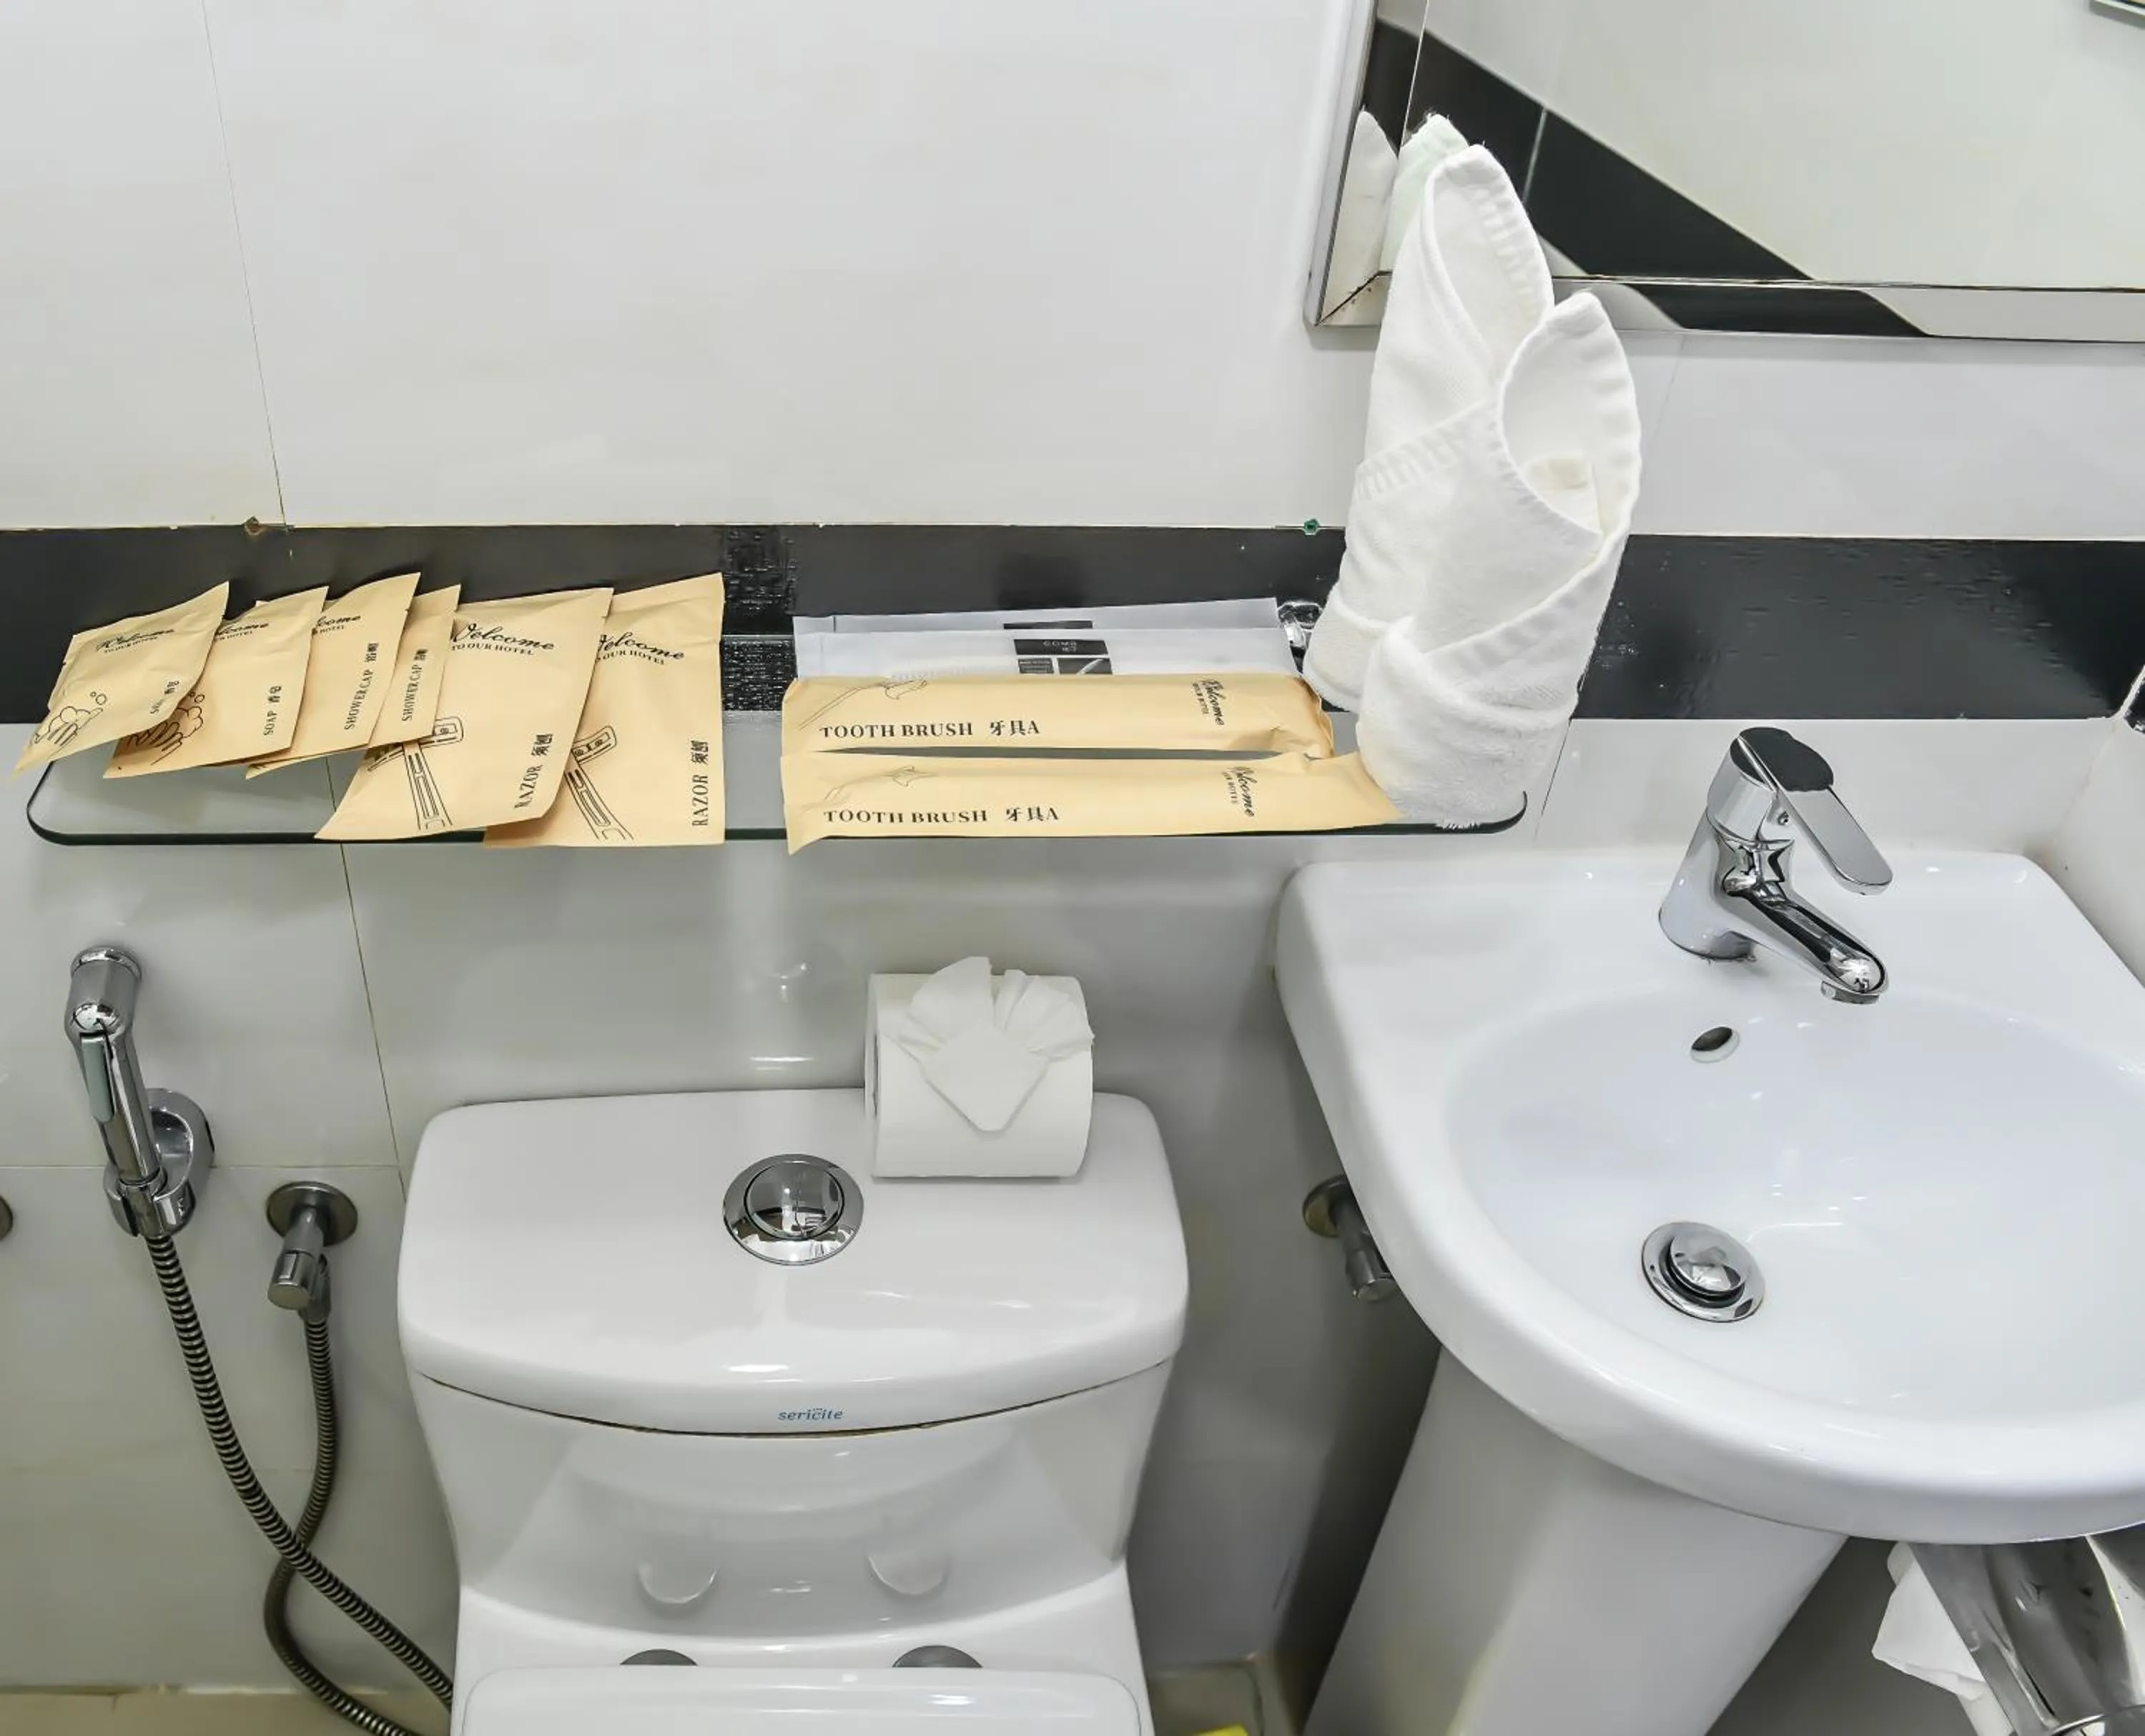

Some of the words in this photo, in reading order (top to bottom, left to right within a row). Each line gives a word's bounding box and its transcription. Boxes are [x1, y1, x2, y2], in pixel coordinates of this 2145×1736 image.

[495, 644, 535, 656] HOTEL
[262, 710, 277, 736] SOAP
[820, 724, 894, 739] TOOTH
[901, 722, 973, 737] BRUSH
[513, 764, 543, 808] RAZOR
[691, 774, 709, 826] RAZOR
[823, 810, 903, 824] TOOTH
[912, 809, 987, 824] BRUSH
